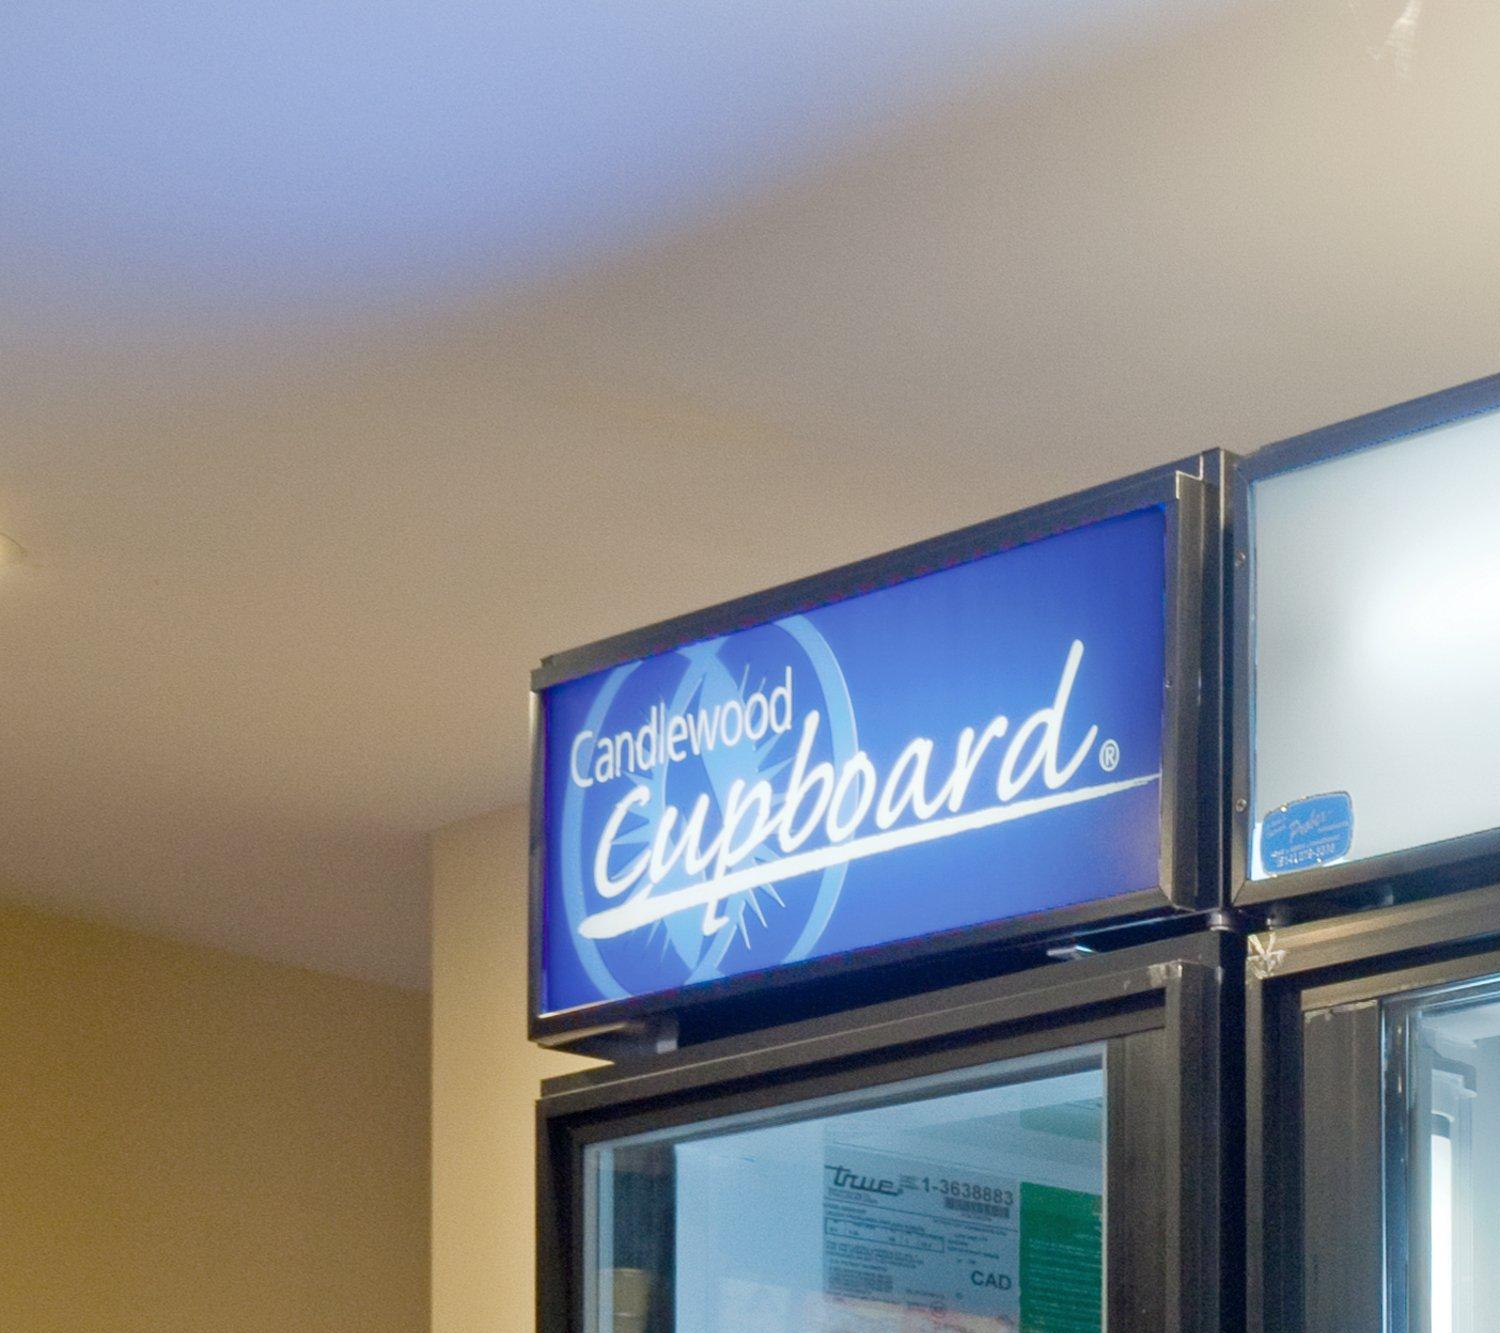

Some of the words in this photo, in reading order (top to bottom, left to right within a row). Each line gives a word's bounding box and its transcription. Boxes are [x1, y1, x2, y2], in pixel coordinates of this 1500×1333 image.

[569, 666, 793, 790] Candlewood
[594, 639, 1098, 935] Cupboard
[922, 1177, 1014, 1205] 1-3638883
[971, 1270, 1012, 1290] CAD
